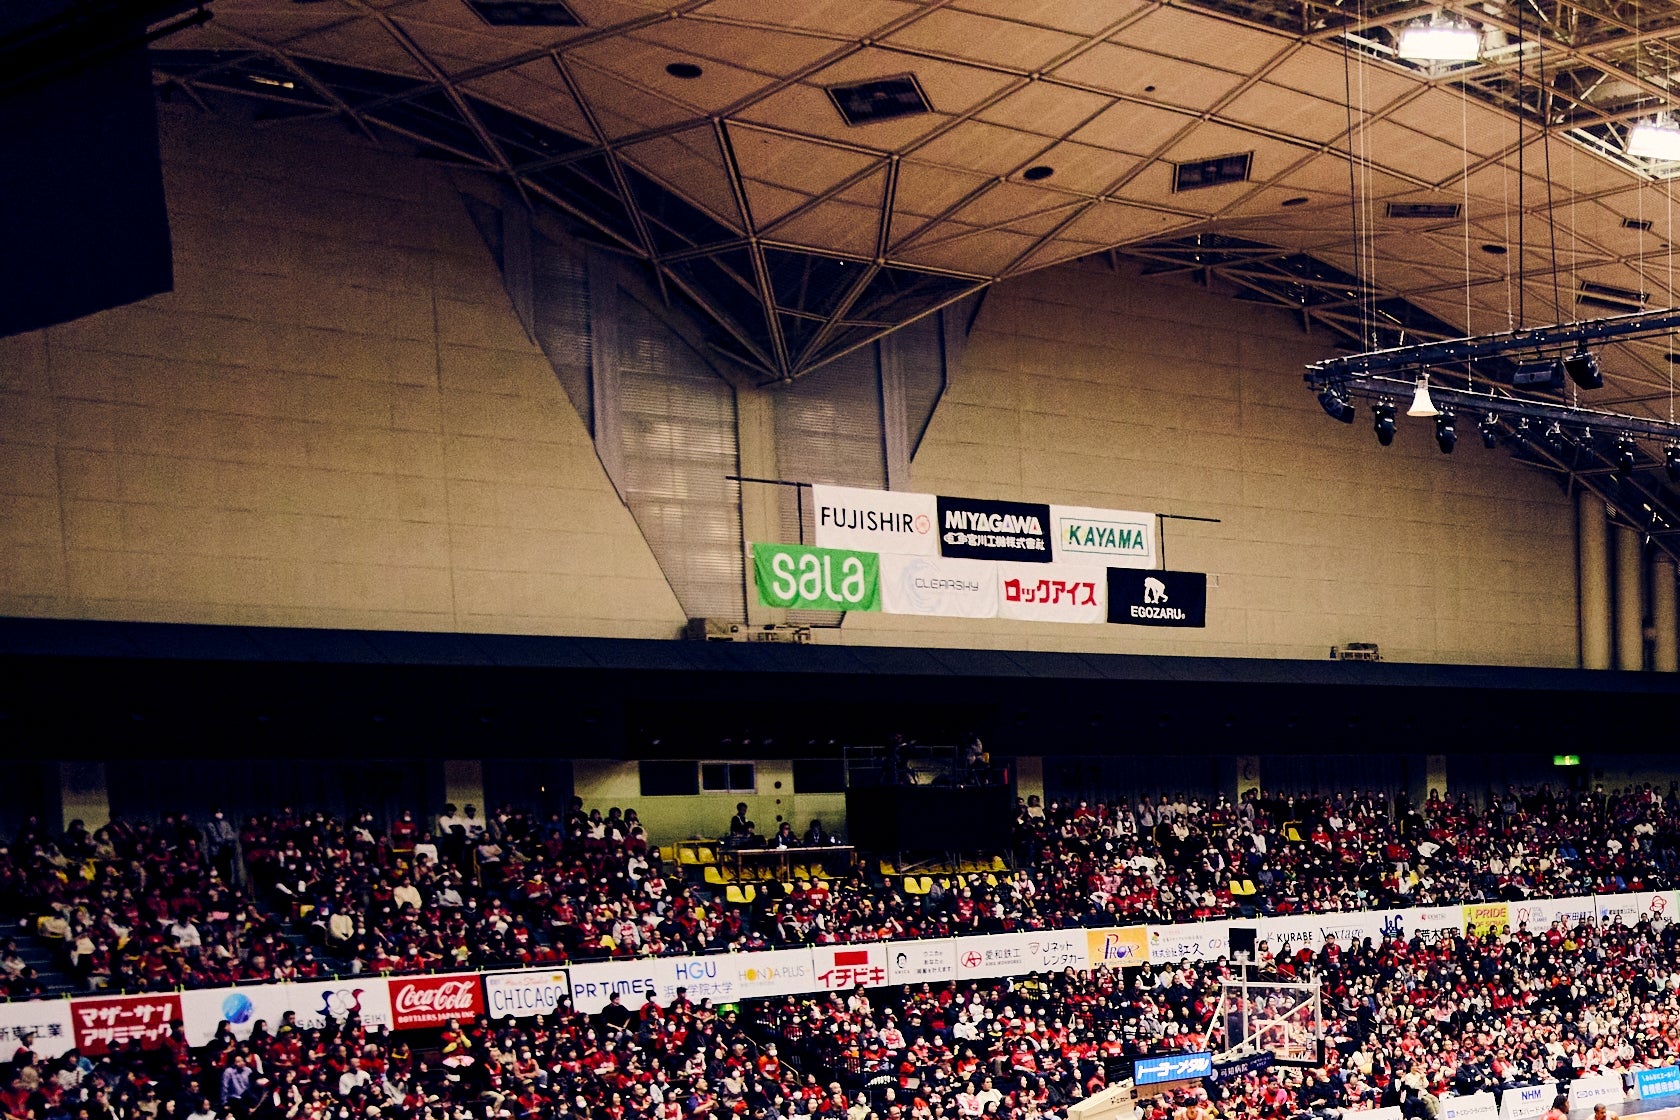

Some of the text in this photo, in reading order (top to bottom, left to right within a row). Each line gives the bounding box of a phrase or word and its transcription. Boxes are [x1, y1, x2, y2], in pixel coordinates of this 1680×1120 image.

[821, 506, 930, 535] FUJISHIRO
[945, 511, 1042, 535] MIYAGAWA
[1069, 524, 1144, 550] KAYAMA
[1005, 578, 1097, 607] ロックアイス
[1131, 606, 1182, 621] EGOZARU
[1475, 907, 1506, 918] PRIDE
[1276, 931, 1313, 943] KURABE
[1044, 954, 1085, 966] レンタカー
[676, 962, 716, 980] HGU
[818, 966, 885, 988] イチビキ
[396, 981, 475, 1013] Coca-Cola
[494, 986, 563, 1011] CHICAGO
[575, 979, 655, 998] PR TIMES
[664, 982, 733, 998] 浜学院大学
[78, 1003, 173, 1027] マザーサン
[398, 1011, 475, 1024] BOTTLERS JAPAN INC
[1138, 1058, 1209, 1080] トーコーメタル
[1521, 1090, 1541, 1100] NHM
